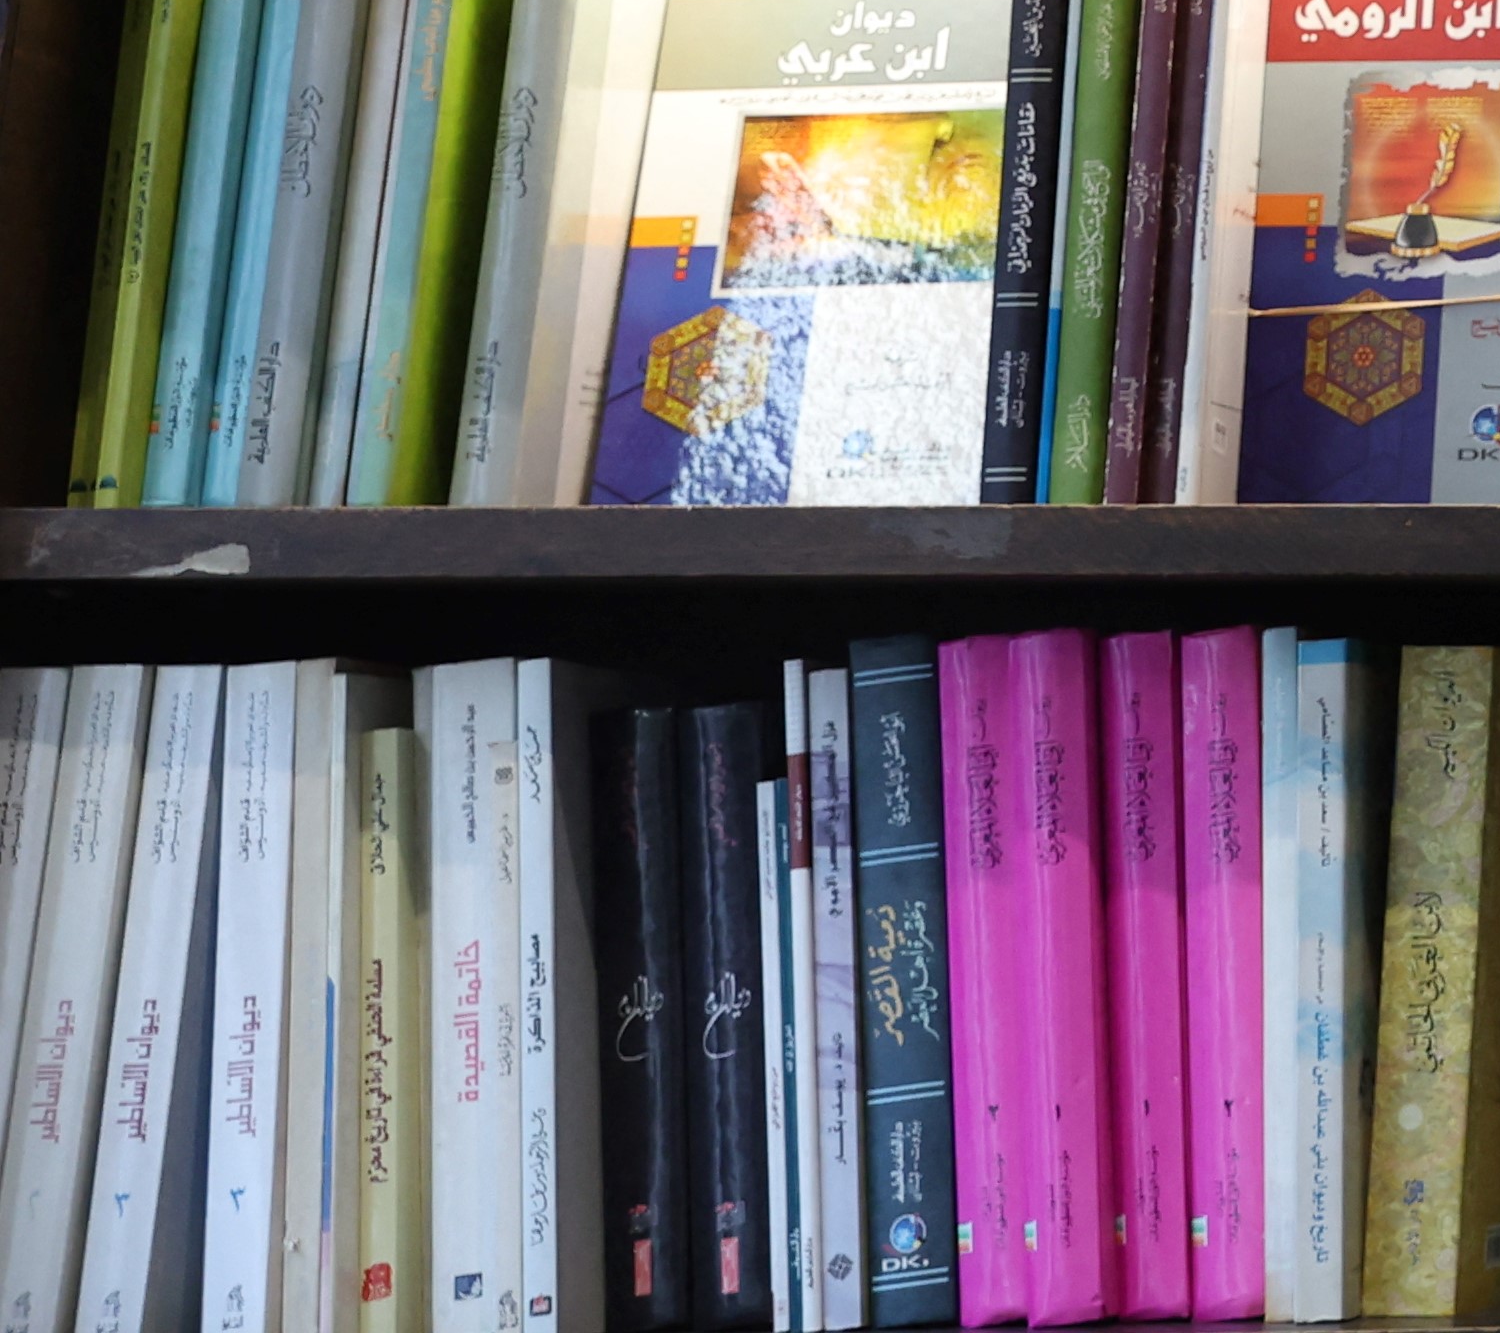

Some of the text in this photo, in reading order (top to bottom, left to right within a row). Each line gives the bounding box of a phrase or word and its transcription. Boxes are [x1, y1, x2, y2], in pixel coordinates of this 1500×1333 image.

[829, 0, 915, 36] ديوان
[776, 26, 951, 83] ابن عربي
[526, 932, 547, 1054] مصابيح الذاكرة
[452, 938, 487, 1104] خاتمة القصيدة
[1310, 1171, 1328, 1222] وديوان
[1308, 1223, 1329, 1263] تاريخ
